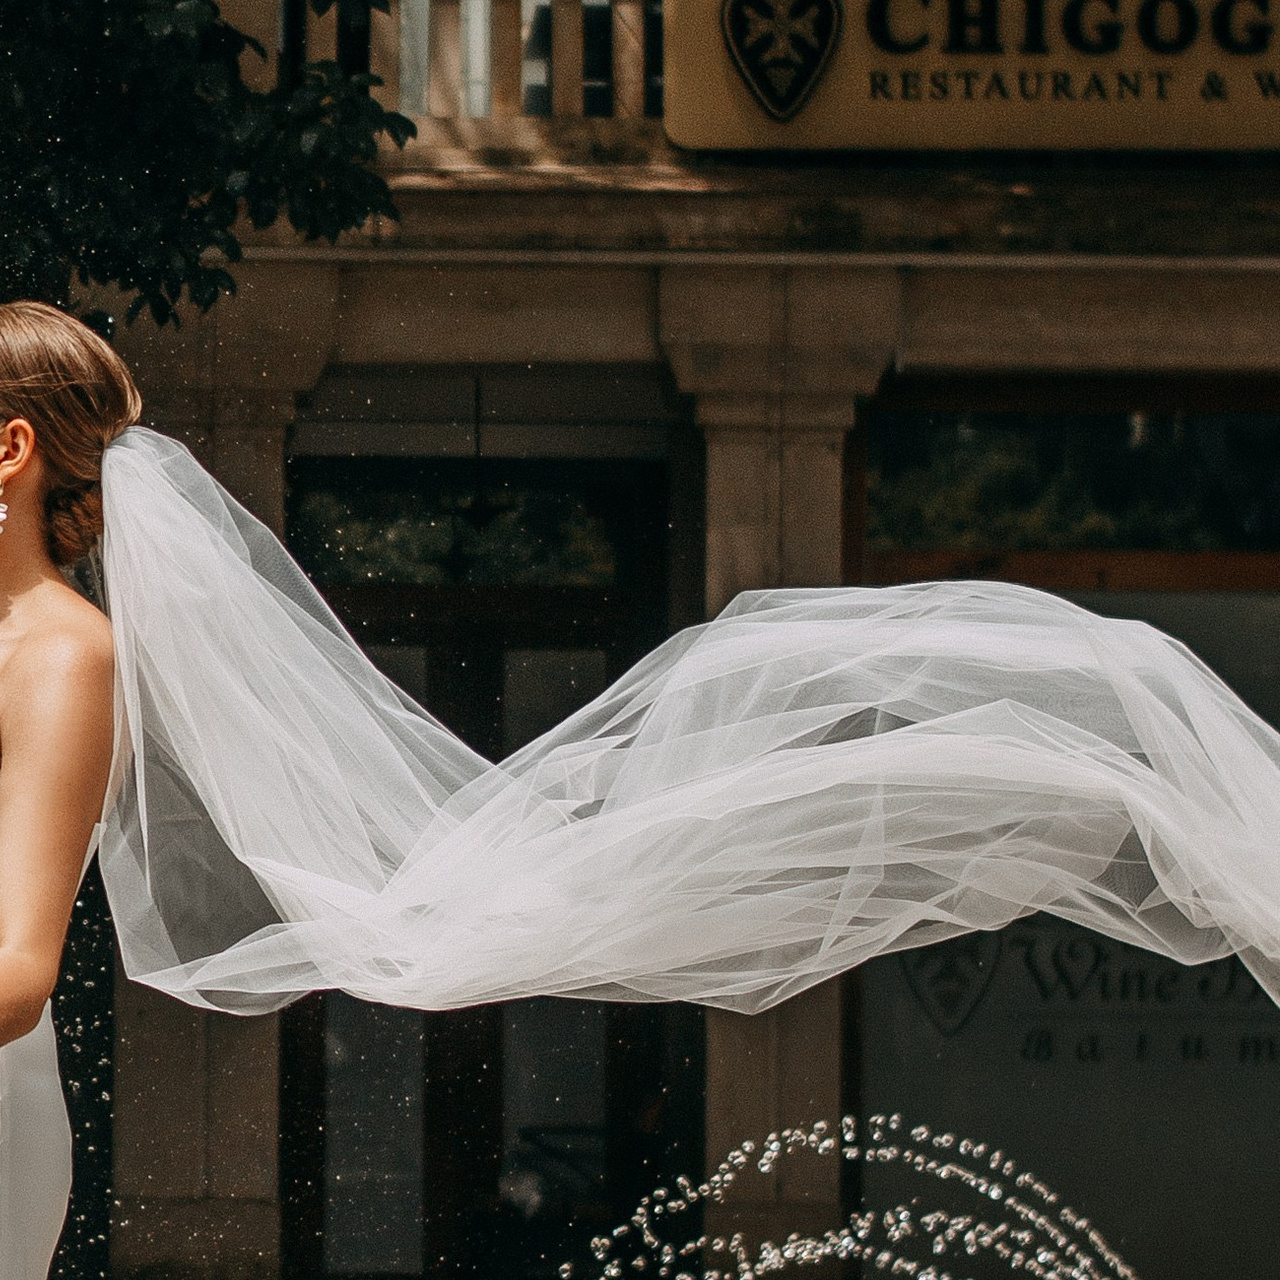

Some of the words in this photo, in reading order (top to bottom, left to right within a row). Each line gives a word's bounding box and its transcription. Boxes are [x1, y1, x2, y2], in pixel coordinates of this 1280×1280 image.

[869, 70, 1169, 101] RESTAURANT
[1200, 70, 1228, 101] &
[1008, 934, 1179, 1003] Wine
